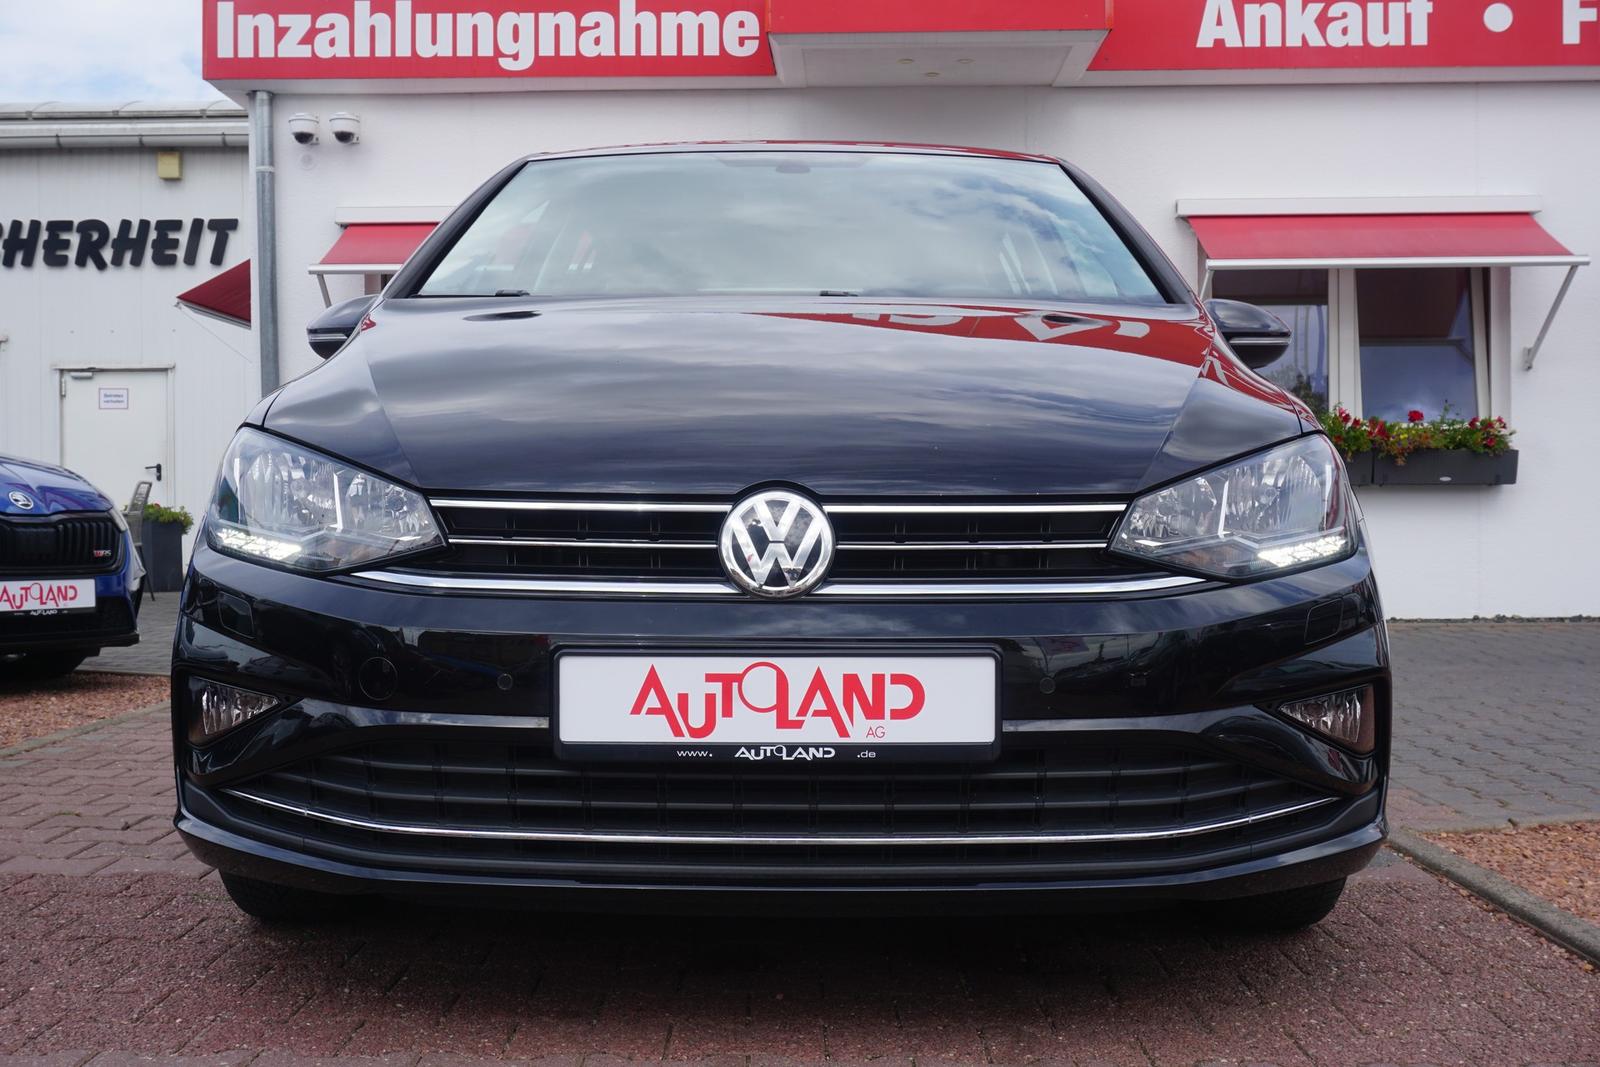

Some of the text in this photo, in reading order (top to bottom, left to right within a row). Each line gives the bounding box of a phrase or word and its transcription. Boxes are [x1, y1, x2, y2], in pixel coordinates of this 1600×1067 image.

[217, 0, 760, 71] Inzahlungnahme
[1196, 0, 1434, 48] Ankauf
[0, 217, 239, 271] HERHEIT
[725, 493, 829, 594] VW
[0, 582, 79, 610] AUTOLAND
[629, 661, 926, 739] AUTOLAND
[676, 744, 876, 761] www. AUTOLAND .de
[865, 726, 886, 739] AG
